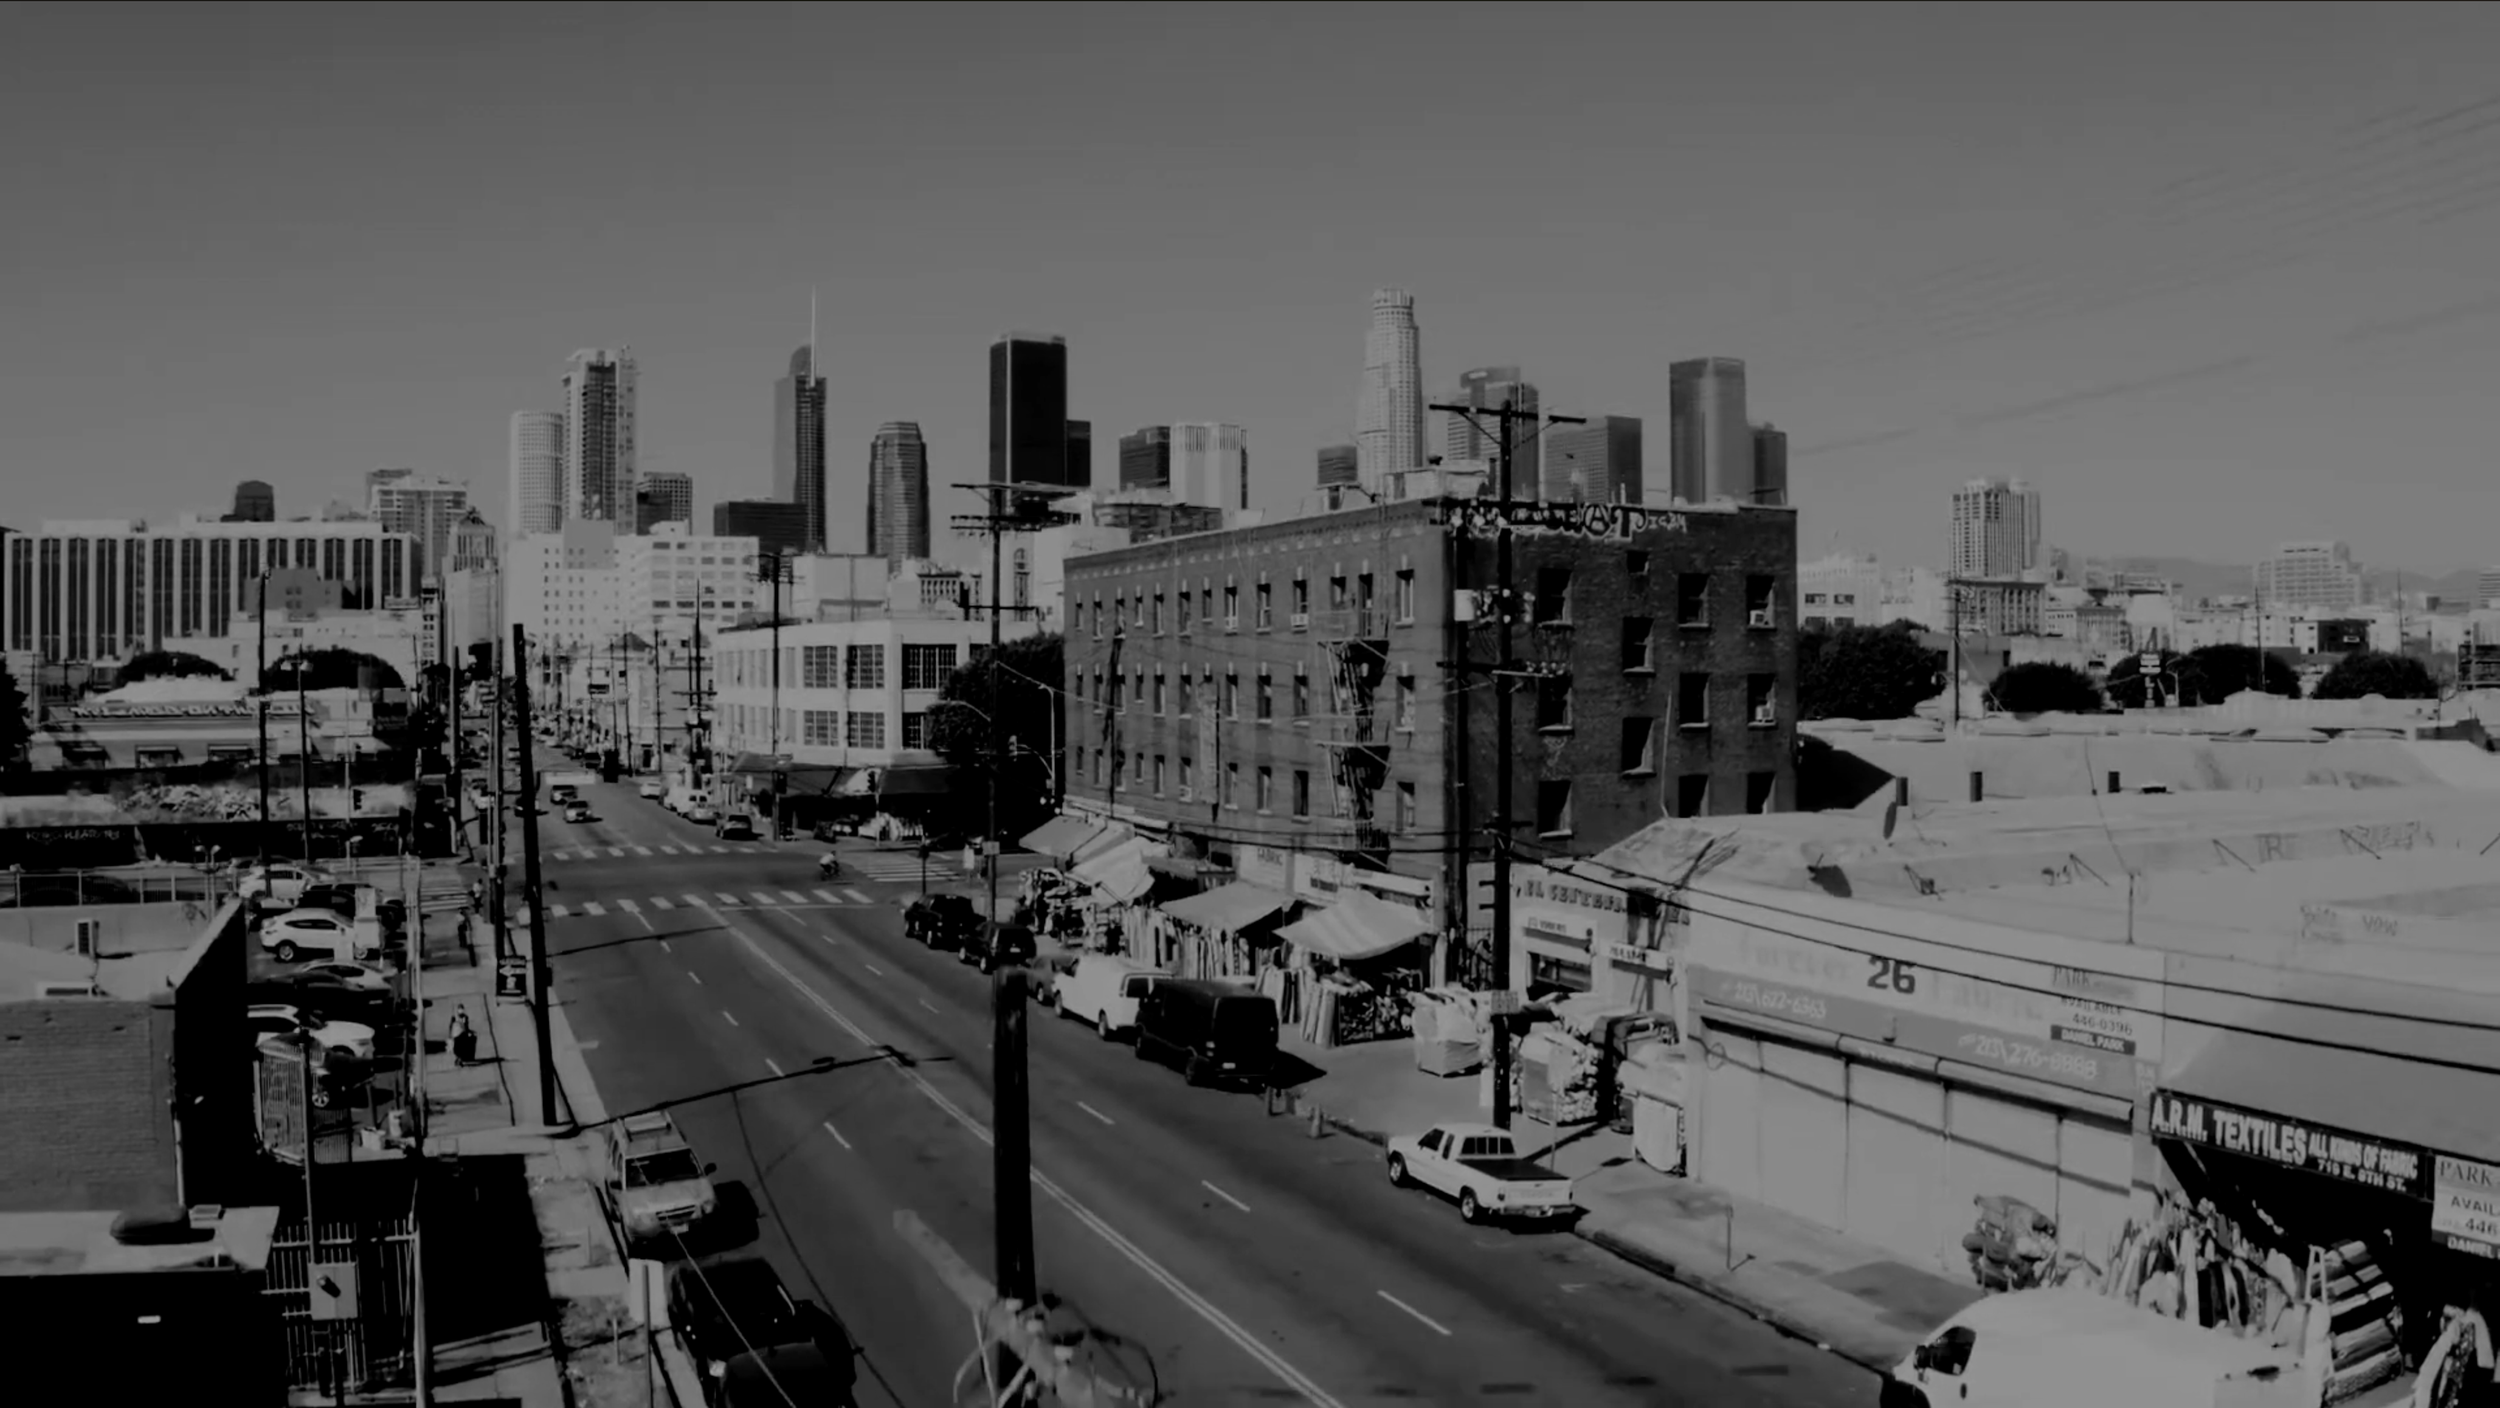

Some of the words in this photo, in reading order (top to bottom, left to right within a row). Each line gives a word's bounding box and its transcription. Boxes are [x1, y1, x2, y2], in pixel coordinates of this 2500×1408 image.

[1864, 955, 1917, 996] 26
[2152, 1096, 2209, 1143] A.R.M.
[2213, 1109, 2308, 1166] TEXTILES
[2308, 1131, 2328, 1159] ALL
[2363, 1145, 2379, 1171] OF
[2379, 1149, 2419, 1181] FABRIC
[2439, 1159, 2494, 1189] PARK
[2449, 1194, 2500, 1217] AVAIL
